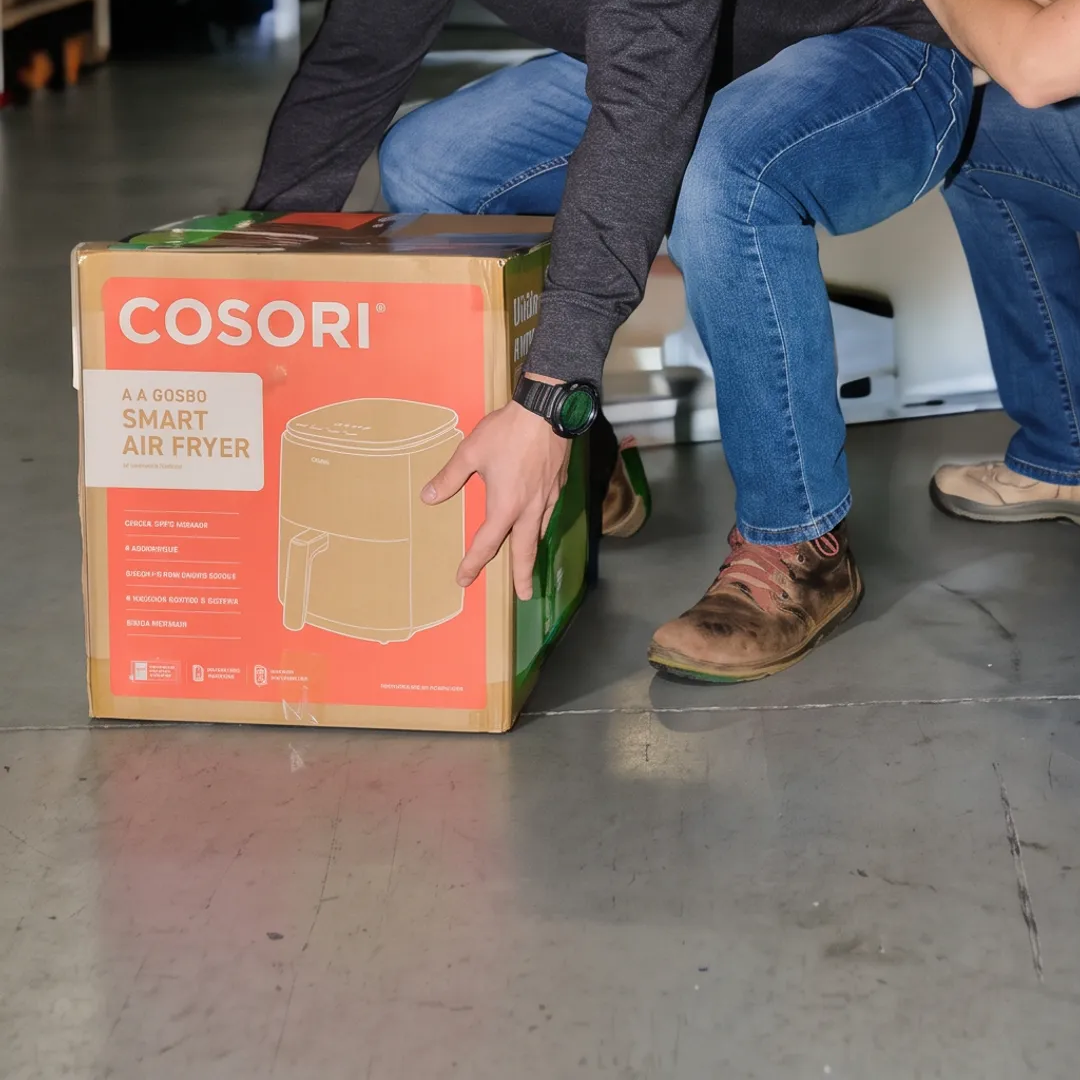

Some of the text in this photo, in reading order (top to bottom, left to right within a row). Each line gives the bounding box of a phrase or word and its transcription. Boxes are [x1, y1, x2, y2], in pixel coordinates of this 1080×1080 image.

[119, 297, 370, 349] COSORI
[121, 388, 132, 402] A
[136, 388, 147, 402] A
[122, 408, 208, 431] SMART
[122, 435, 250, 459] AIR FRYER
